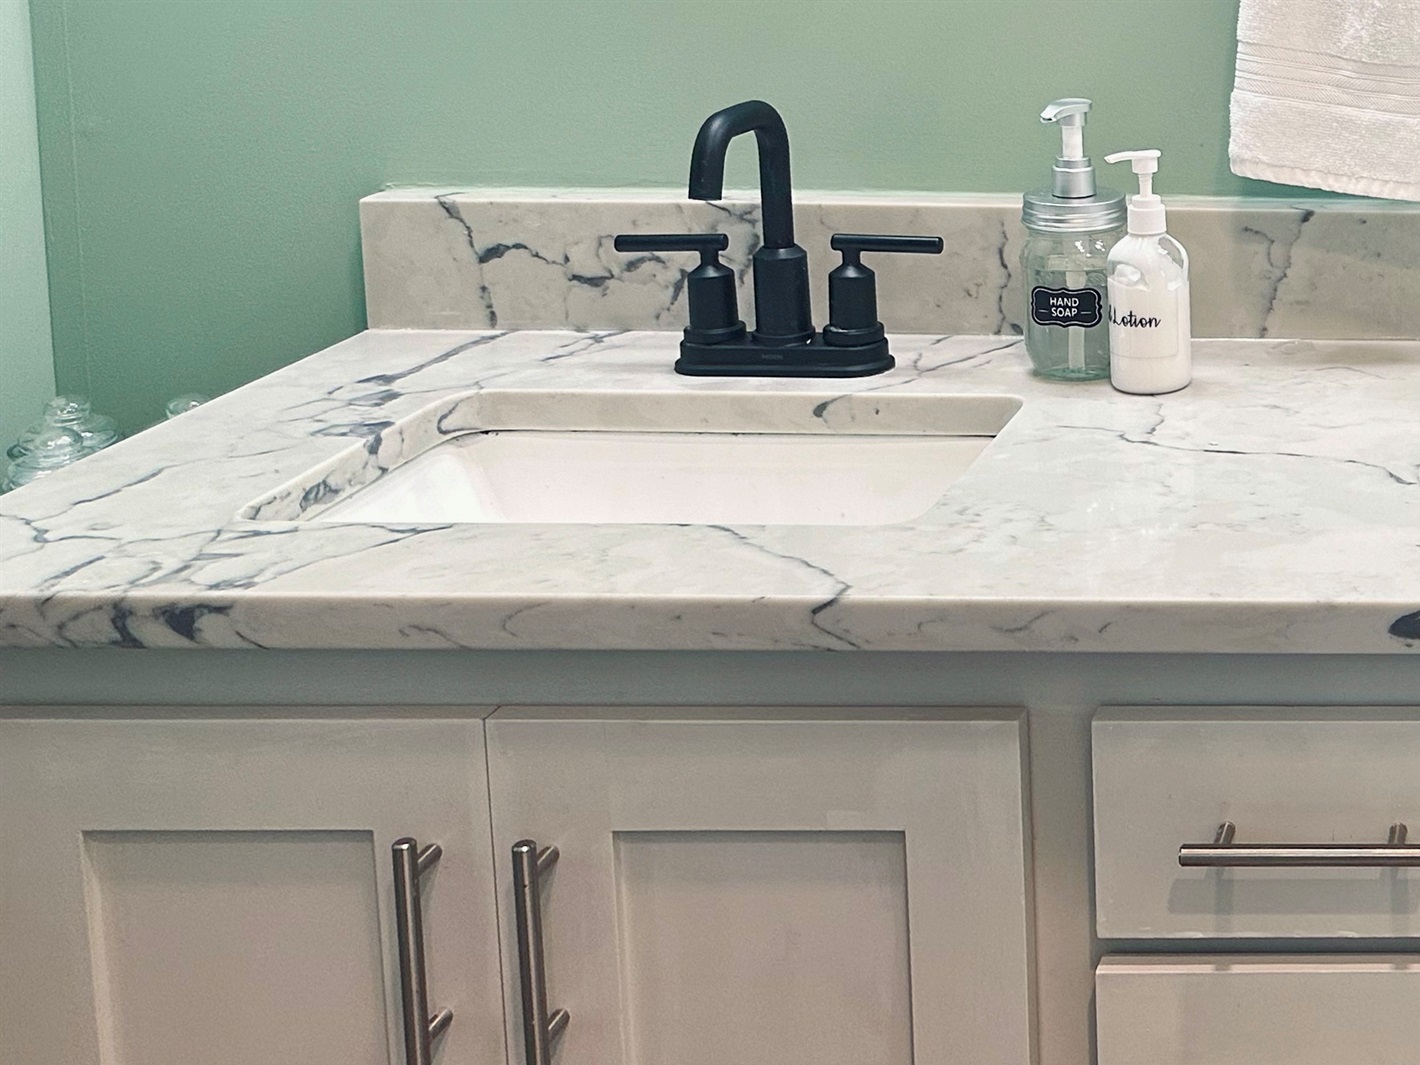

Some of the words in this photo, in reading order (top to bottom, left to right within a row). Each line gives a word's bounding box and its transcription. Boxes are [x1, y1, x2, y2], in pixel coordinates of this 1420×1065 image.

[1050, 297, 1079, 307] HAND
[1051, 307, 1078, 317] SOAP
[1112, 306, 1161, 328] Lotion
